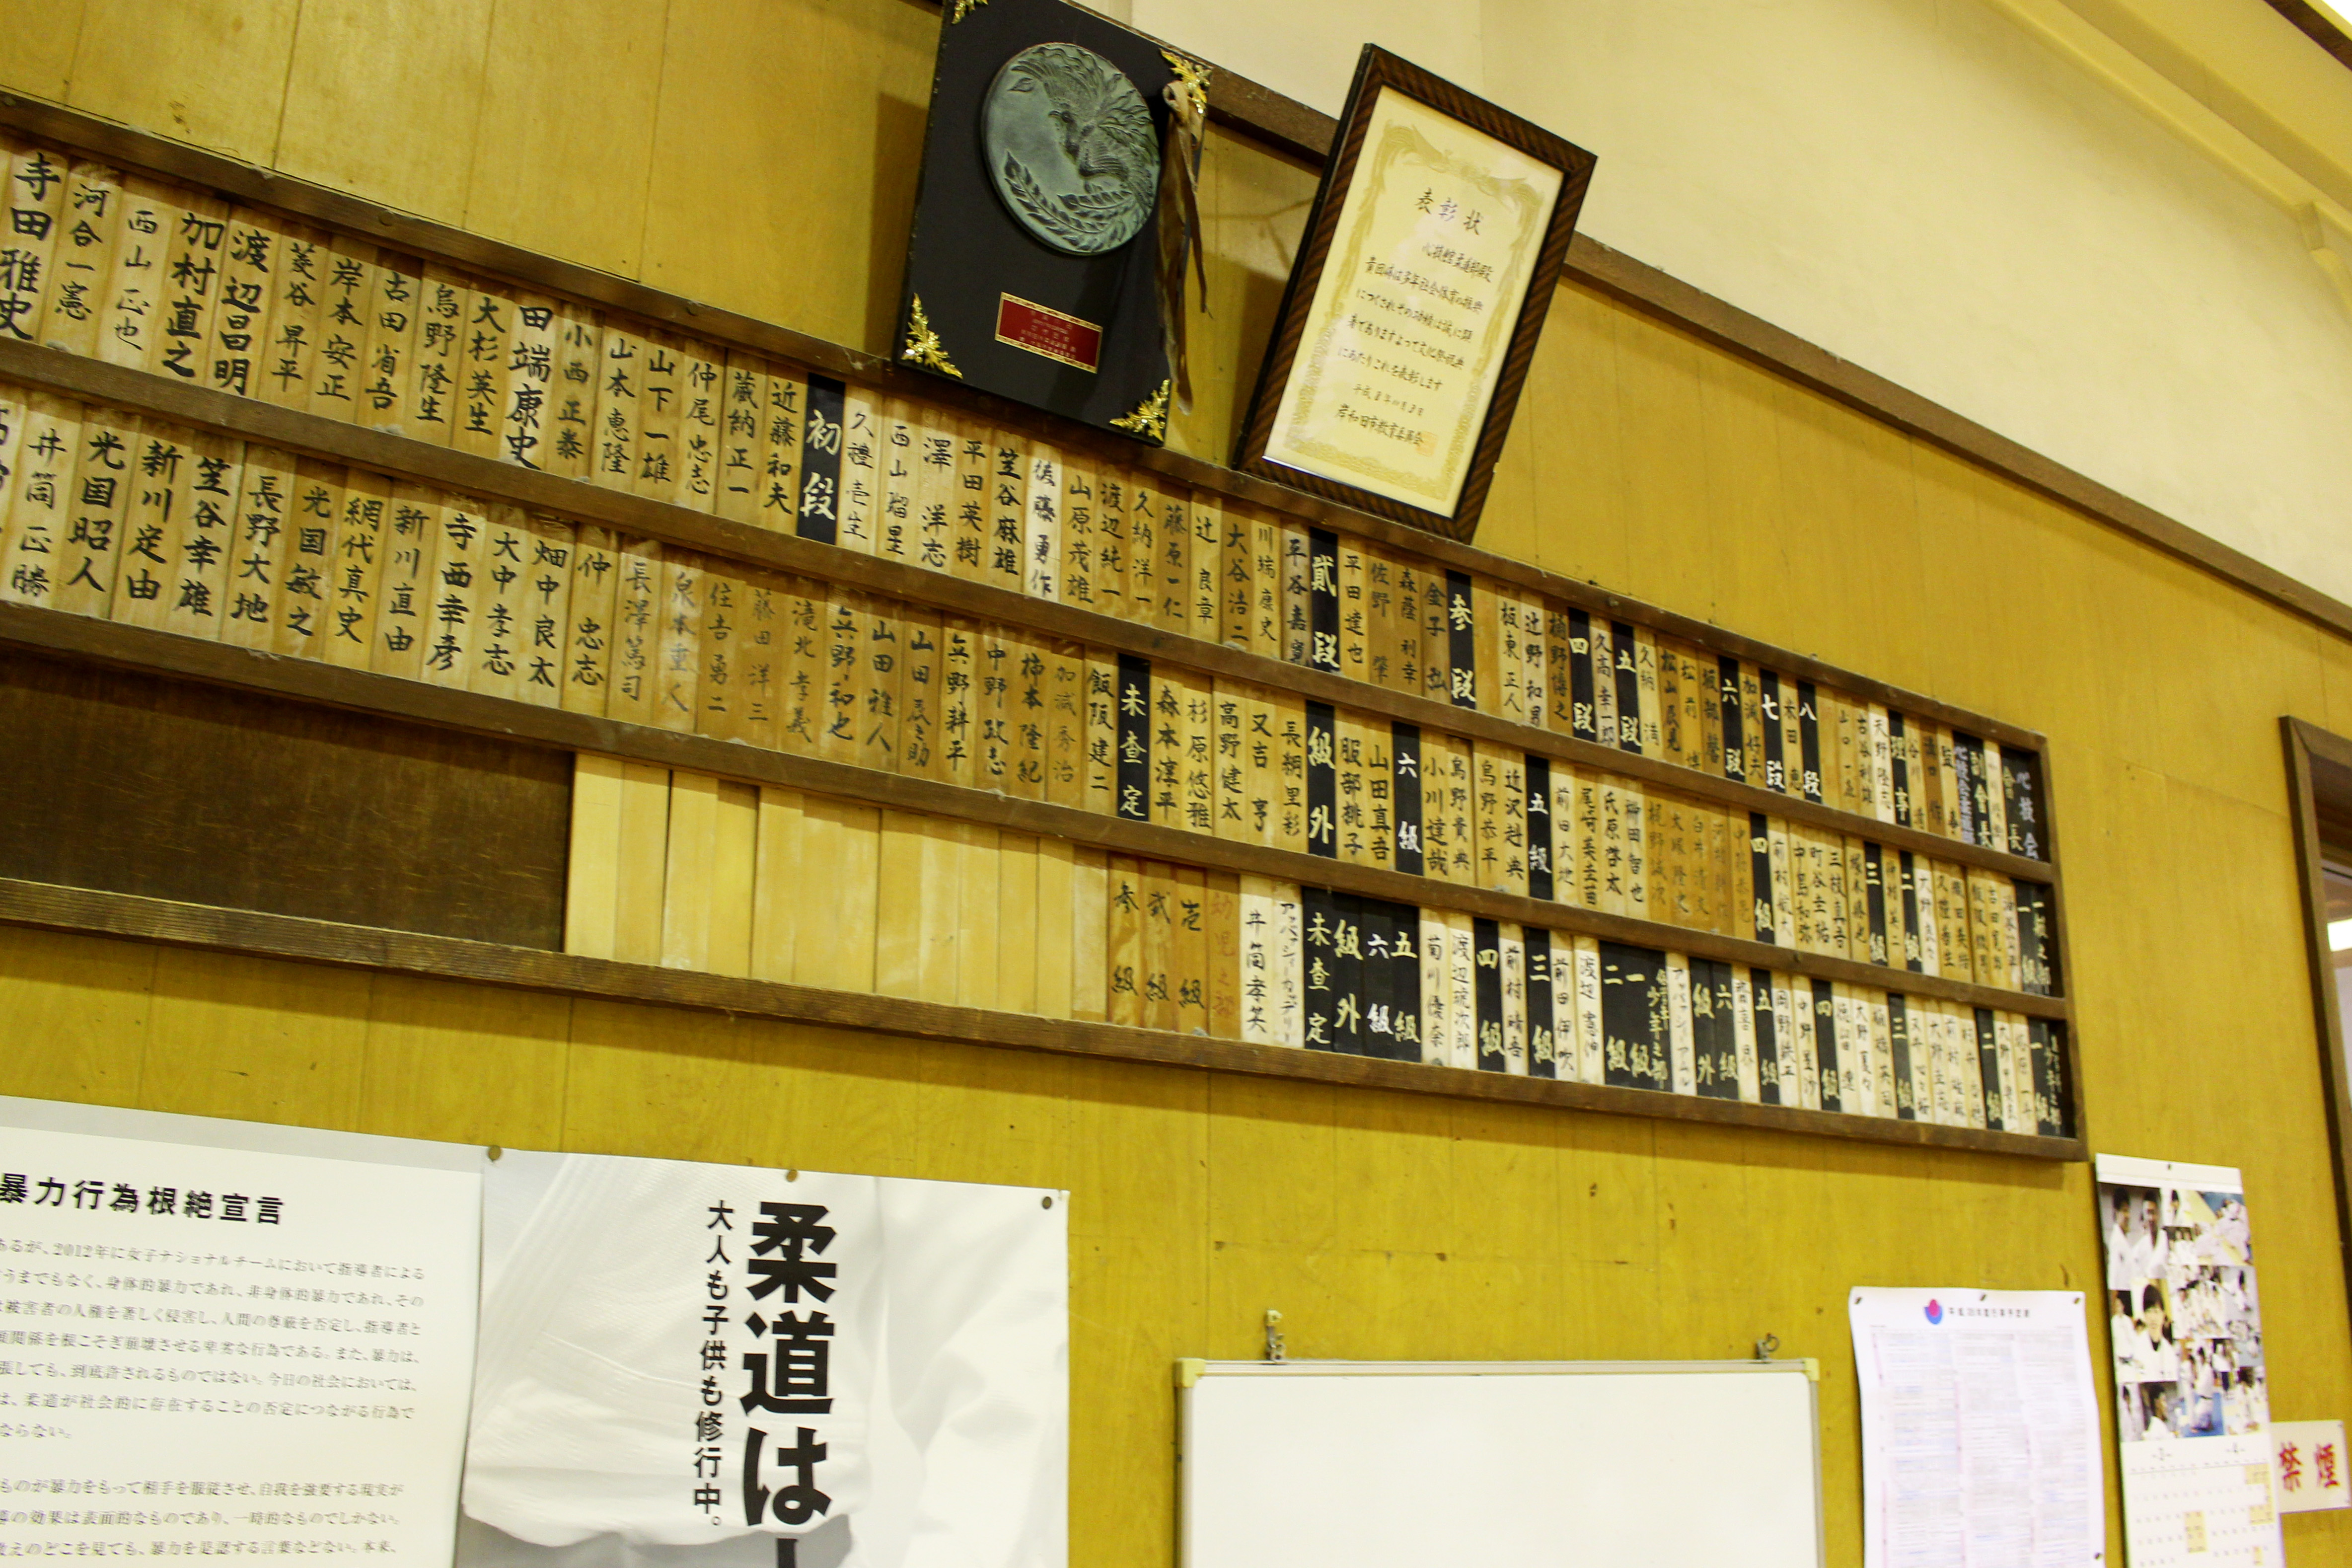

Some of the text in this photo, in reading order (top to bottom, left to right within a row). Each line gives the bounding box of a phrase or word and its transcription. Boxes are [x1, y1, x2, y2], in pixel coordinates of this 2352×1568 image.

[0, 153, 61, 341] 寺田雅史
[1414, 187, 1484, 235] 表彰状
[116, 210, 159, 350] 西山正也
[163, 212, 223, 377] 加村直之
[215, 229, 272, 396] 渡辺昌明
[316, 258, 364, 401] 岸本安正
[465, 297, 506, 436] 大杉英生
[506, 306, 554, 471] 田端康史
[556, 325, 592, 459] 小西正泰
[640, 350, 675, 484] 山下一雄
[686, 363, 718, 495] 仲尾忠志
[764, 381, 798, 516] 近藤和夫
[799, 409, 842, 521] 初段
[67, 431, 125, 593] 光国昭人
[174, 456, 231, 616] 笠谷幸雄
[230, 475, 283, 623] 長野大地
[286, 486, 332, 637] 光国敏之
[956, 439, 986, 567] 平田英樹
[384, 506, 430, 652] 新川直由
[426, 514, 477, 671] 寺西幸彦
[482, 532, 522, 676] 大中孝志
[528, 540, 568, 687] 畑中良太
[572, 552, 611, 686] 仲忠志
[1569, 637, 1596, 734] 四段
[1615, 649, 1642, 747] 五段
[1721, 679, 1745, 776] 六段
[1762, 695, 1785, 790] 七段
[1119, 683, 1147, 817] 未査定
[1308, 726, 1336, 844] 級外
[1397, 751, 1422, 853] 六級
[1799, 702, 1822, 798] 八段
[1527, 792, 1552, 874] 五級
[1866, 862, 1888, 963] 三級
[1902, 873, 1922, 963] 二級
[1306, 912, 1331, 1044] 未査定
[1334, 919, 1363, 1035] 級外
[1367, 933, 1394, 1035] 六級
[1391, 931, 1421, 1044] 五級
[1476, 949, 1505, 1057] 四級
[1530, 955, 1556, 1064] 三級
[1604, 965, 1631, 1072] 二級
[1626, 973, 1652, 1078] 一級
[1716, 984, 1738, 1082] 六級
[1756, 988, 1779, 1086] 五級
[0, 1172, 285, 1225] 暴力行為根絶宣言
[0, 1269, 424, 1308] うまでもなく、身体的暴力であれ、非身体的暴力であれ、その
[0, 1299, 421, 1336] 被害者の人権を著しく侵害し、人間の尊厳を否定し、指導者と
[693, 1199, 735, 1527] 大人も子供も修行中。
[2278, 1441, 2340, 1492] 禁煙
